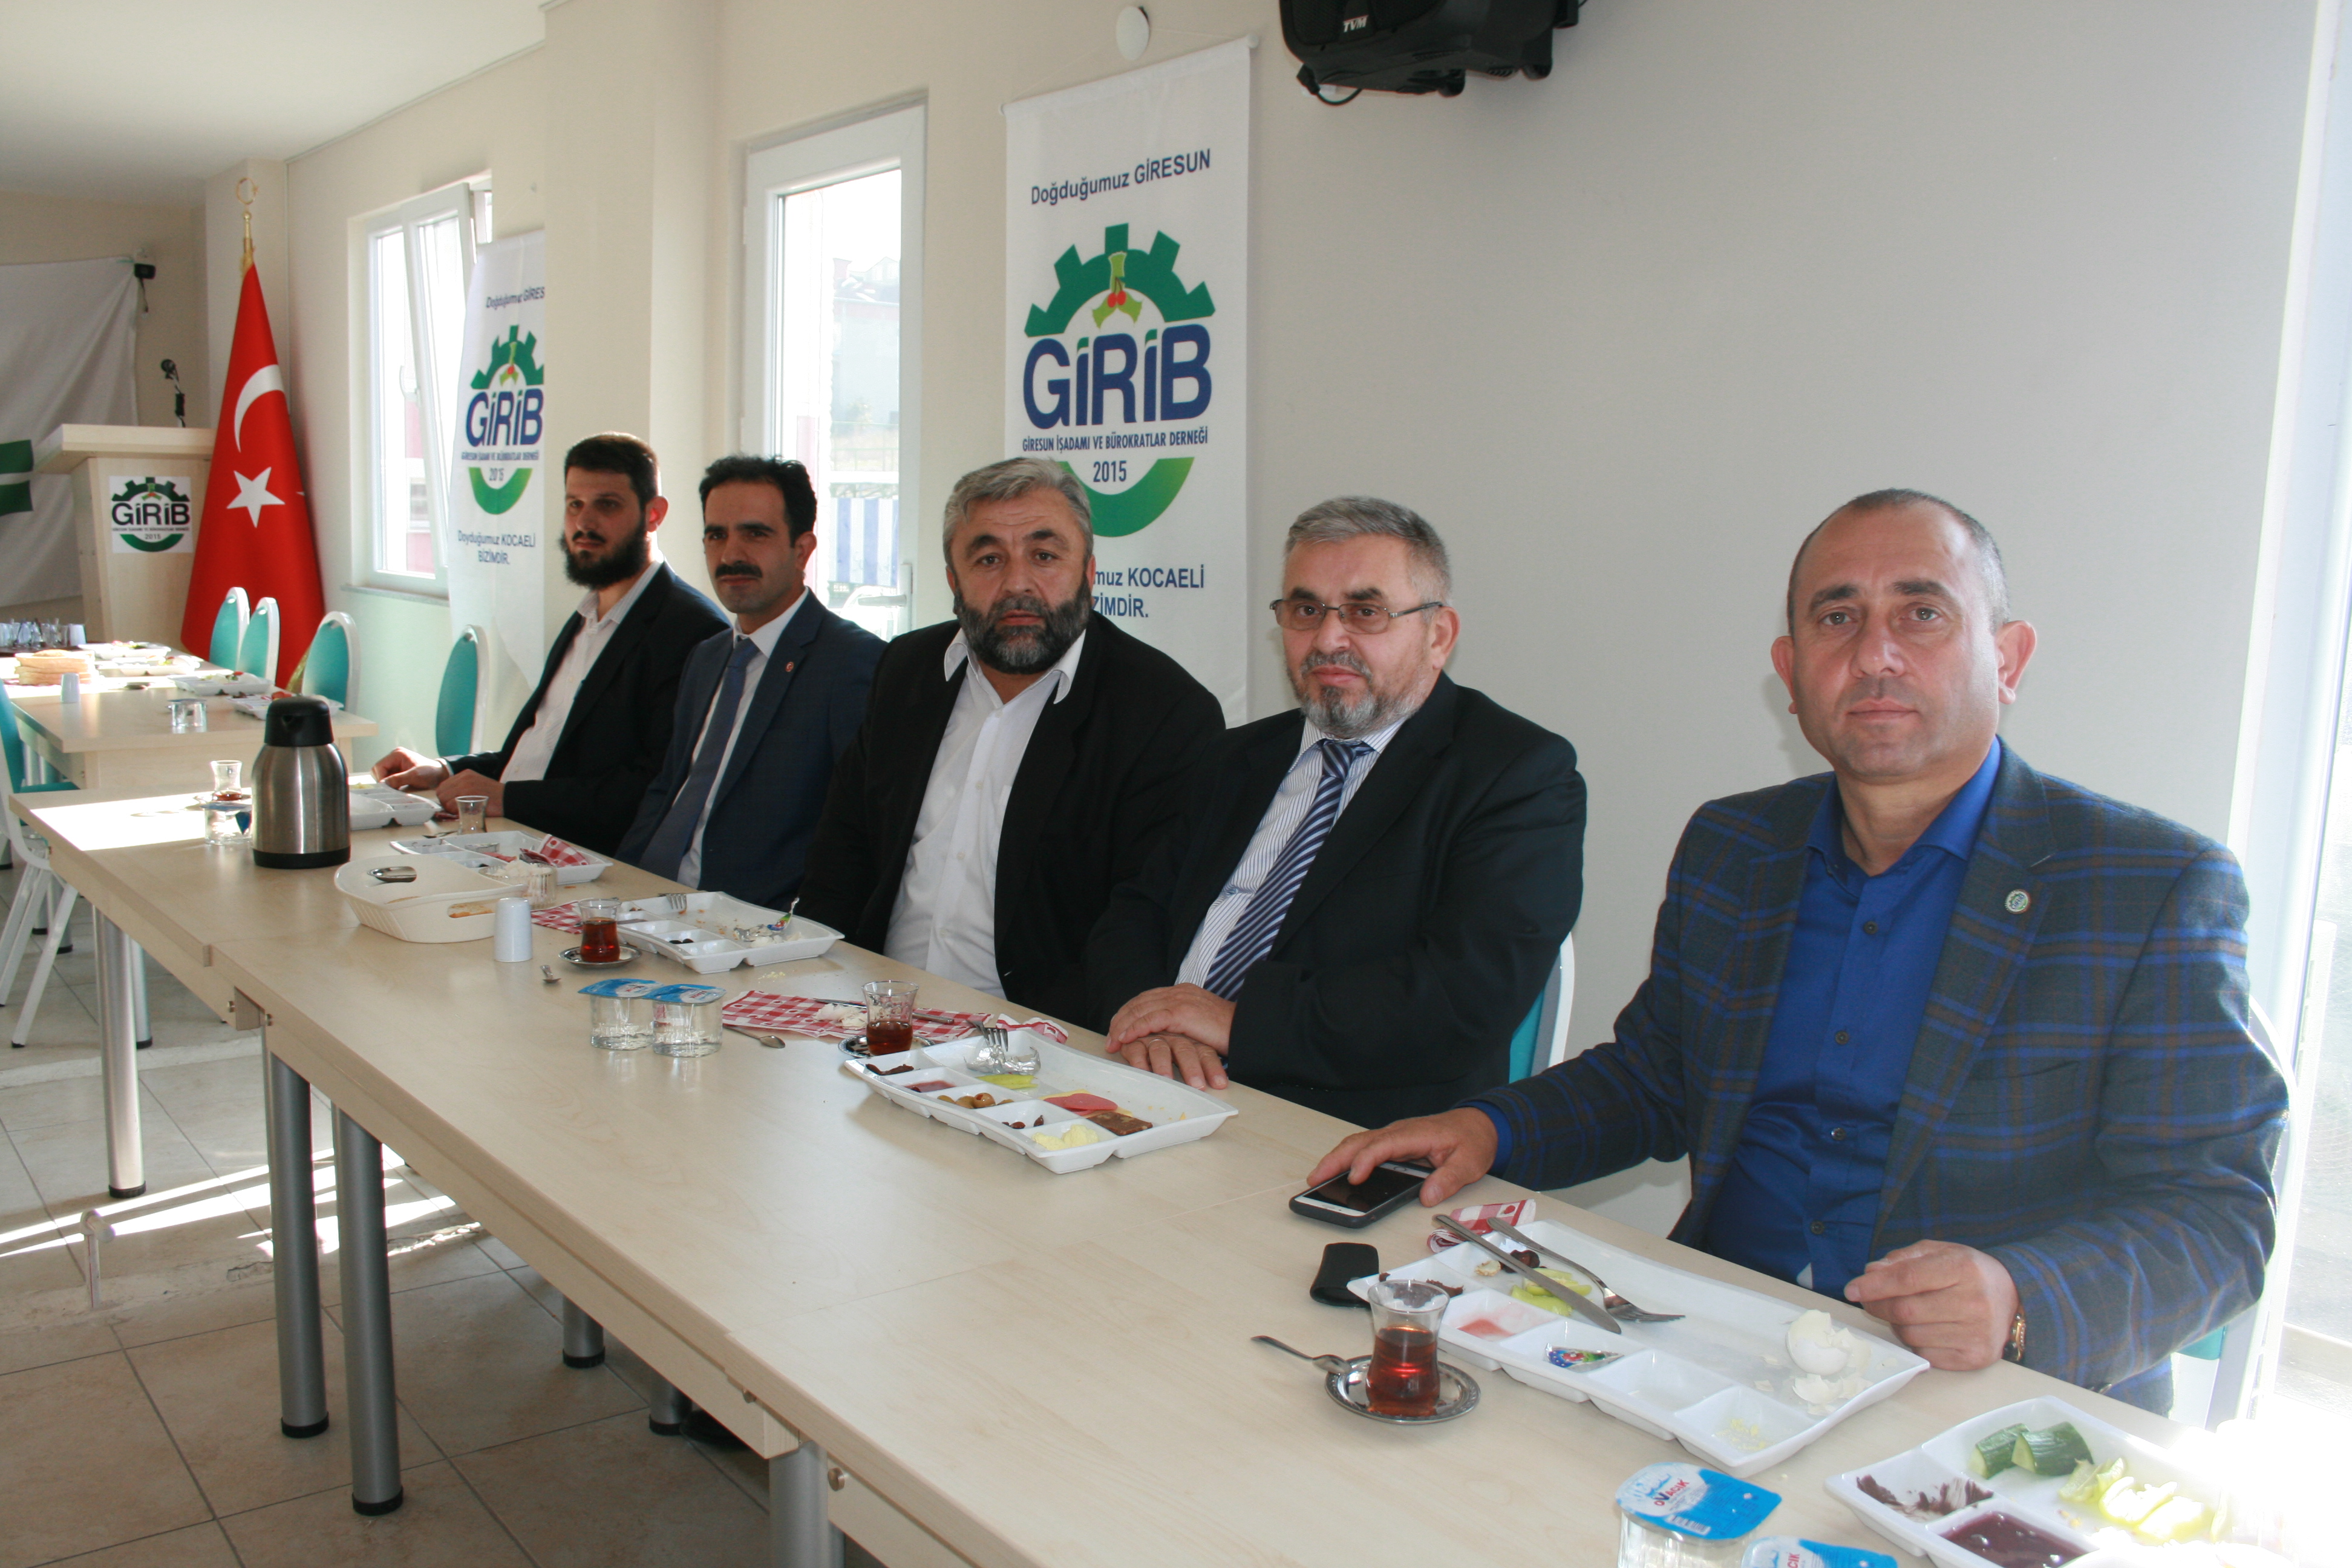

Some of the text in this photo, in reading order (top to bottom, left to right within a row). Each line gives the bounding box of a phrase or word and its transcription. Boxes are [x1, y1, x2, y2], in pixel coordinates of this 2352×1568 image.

[1343, 15, 1368, 32] TVM
[1031, 148, 1210, 205] Doğduğumuz GİRESUN
[523, 286, 544, 301] GİRES
[1023, 323, 1212, 430] GİRİB
[465, 388, 544, 447] GİRİB
[1023, 426, 1208, 453] GİRESUN İŞADAMI VE BÜROKRATLAR DERNEĞİ
[1093, 460, 1127, 482] 2015
[111, 502, 191, 526] GİRİB
[1128, 564, 1204, 588] KOCAELİ
[1092, 592, 1149, 618] ZİMDİR.
